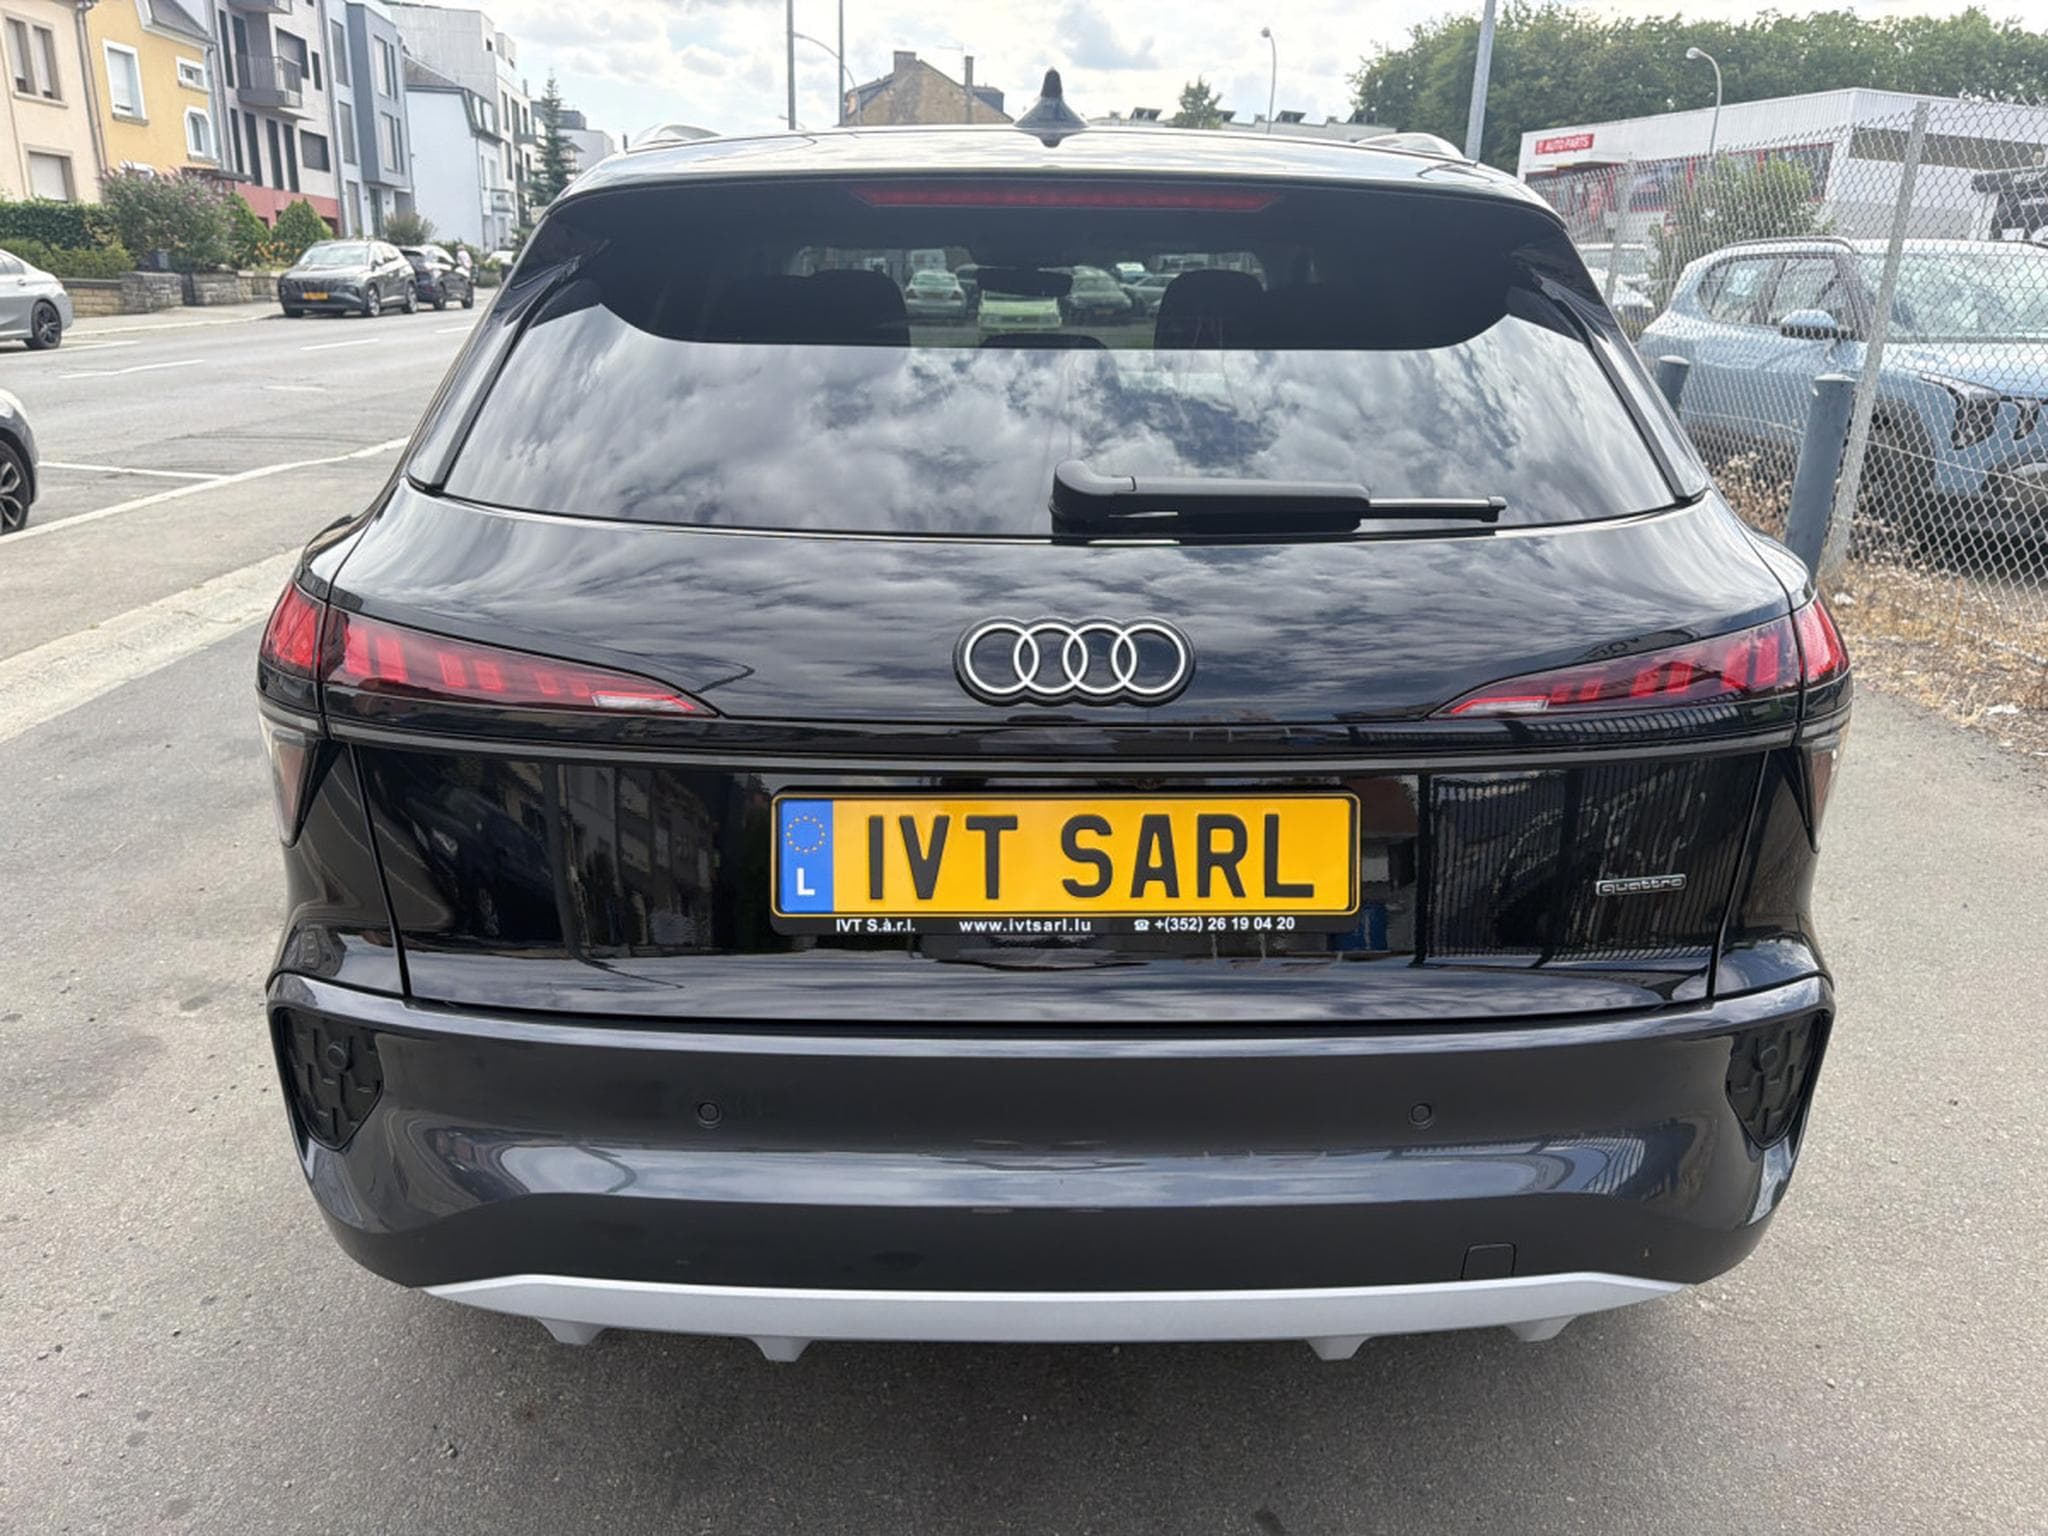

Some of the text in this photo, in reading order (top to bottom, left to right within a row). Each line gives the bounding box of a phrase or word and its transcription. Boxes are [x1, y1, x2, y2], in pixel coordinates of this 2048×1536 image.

[867, 813, 1314, 900] IVT SARL
[796, 867, 815, 896] L
[1601, 878, 1683, 895] quattro
[835, 917, 916, 932] IVT S.à.r.l.
[958, 917, 1092, 933] www.ivtsarl.lu
[1154, 915, 1296, 933] +(352) 26 19 04 20
